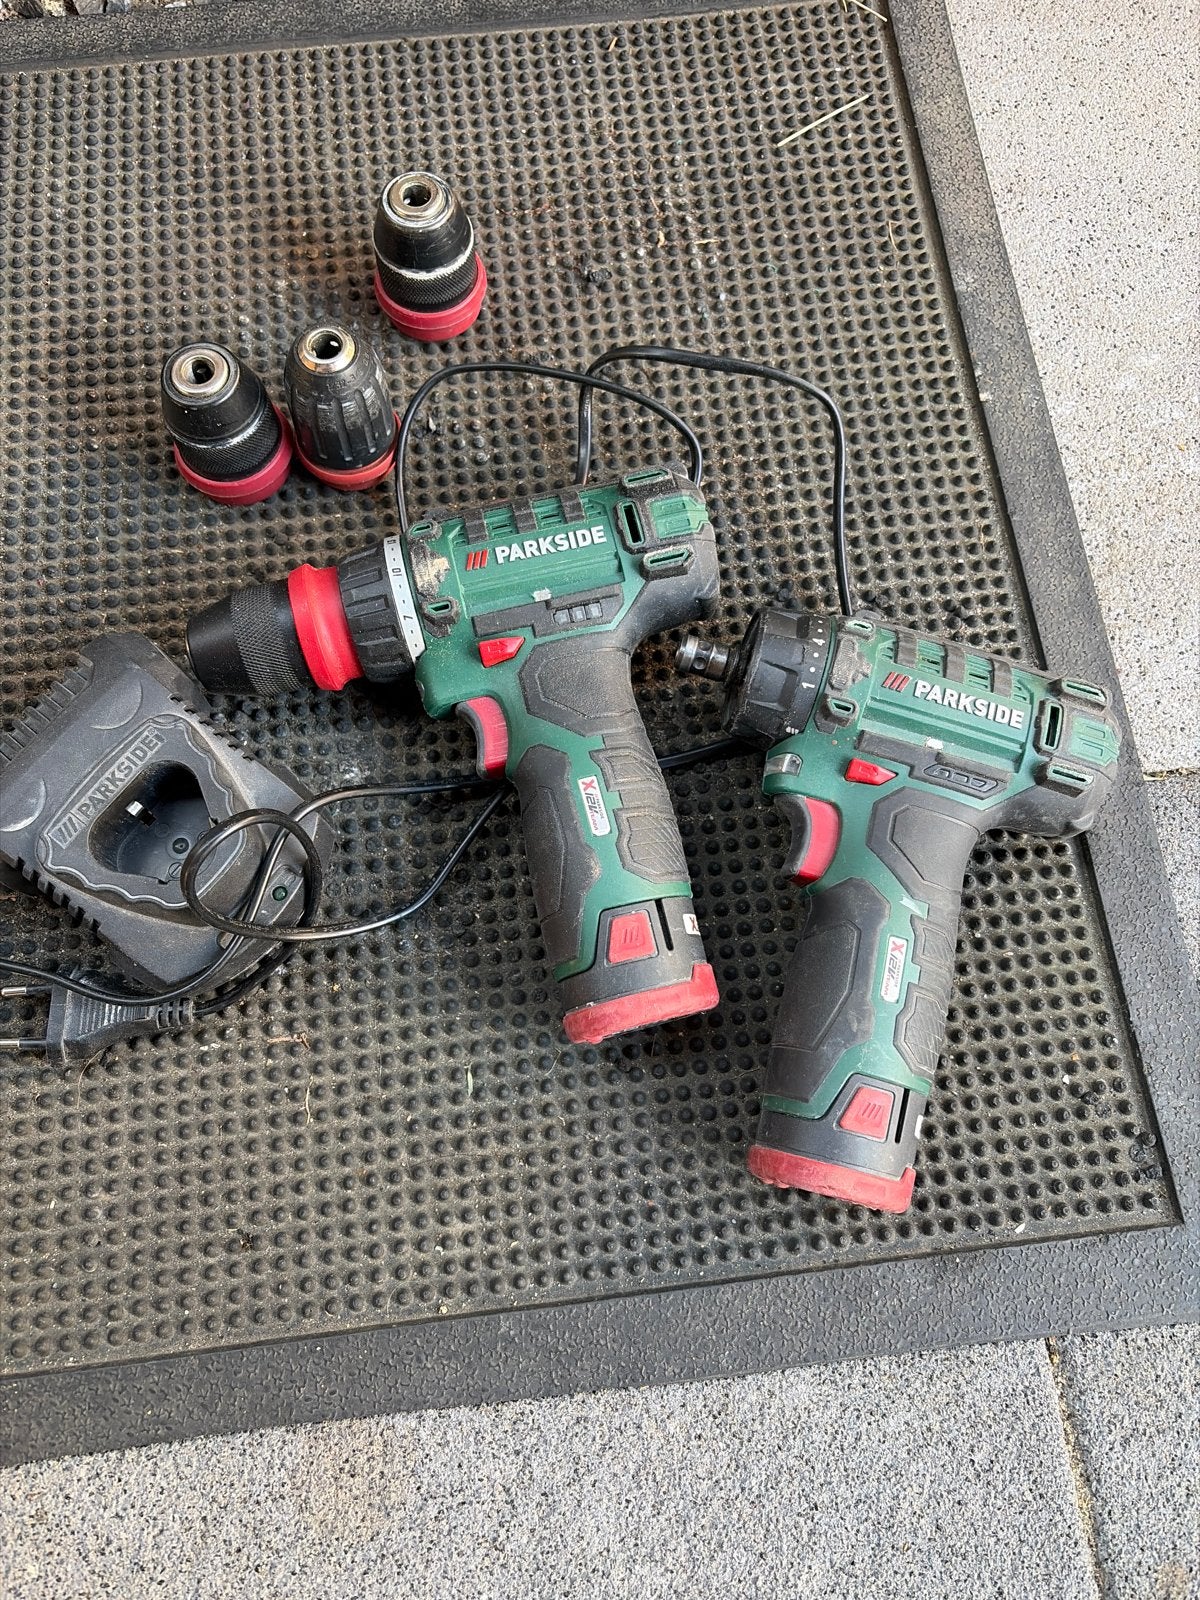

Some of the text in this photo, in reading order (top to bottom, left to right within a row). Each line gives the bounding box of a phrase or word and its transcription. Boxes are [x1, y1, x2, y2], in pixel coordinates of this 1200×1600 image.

[494, 525, 607, 565] PARKSIDE
[392, 567, 403, 577] 10
[914, 679, 1024, 730] PARKSIDE
[77, 733, 160, 820] PARKSIDE
